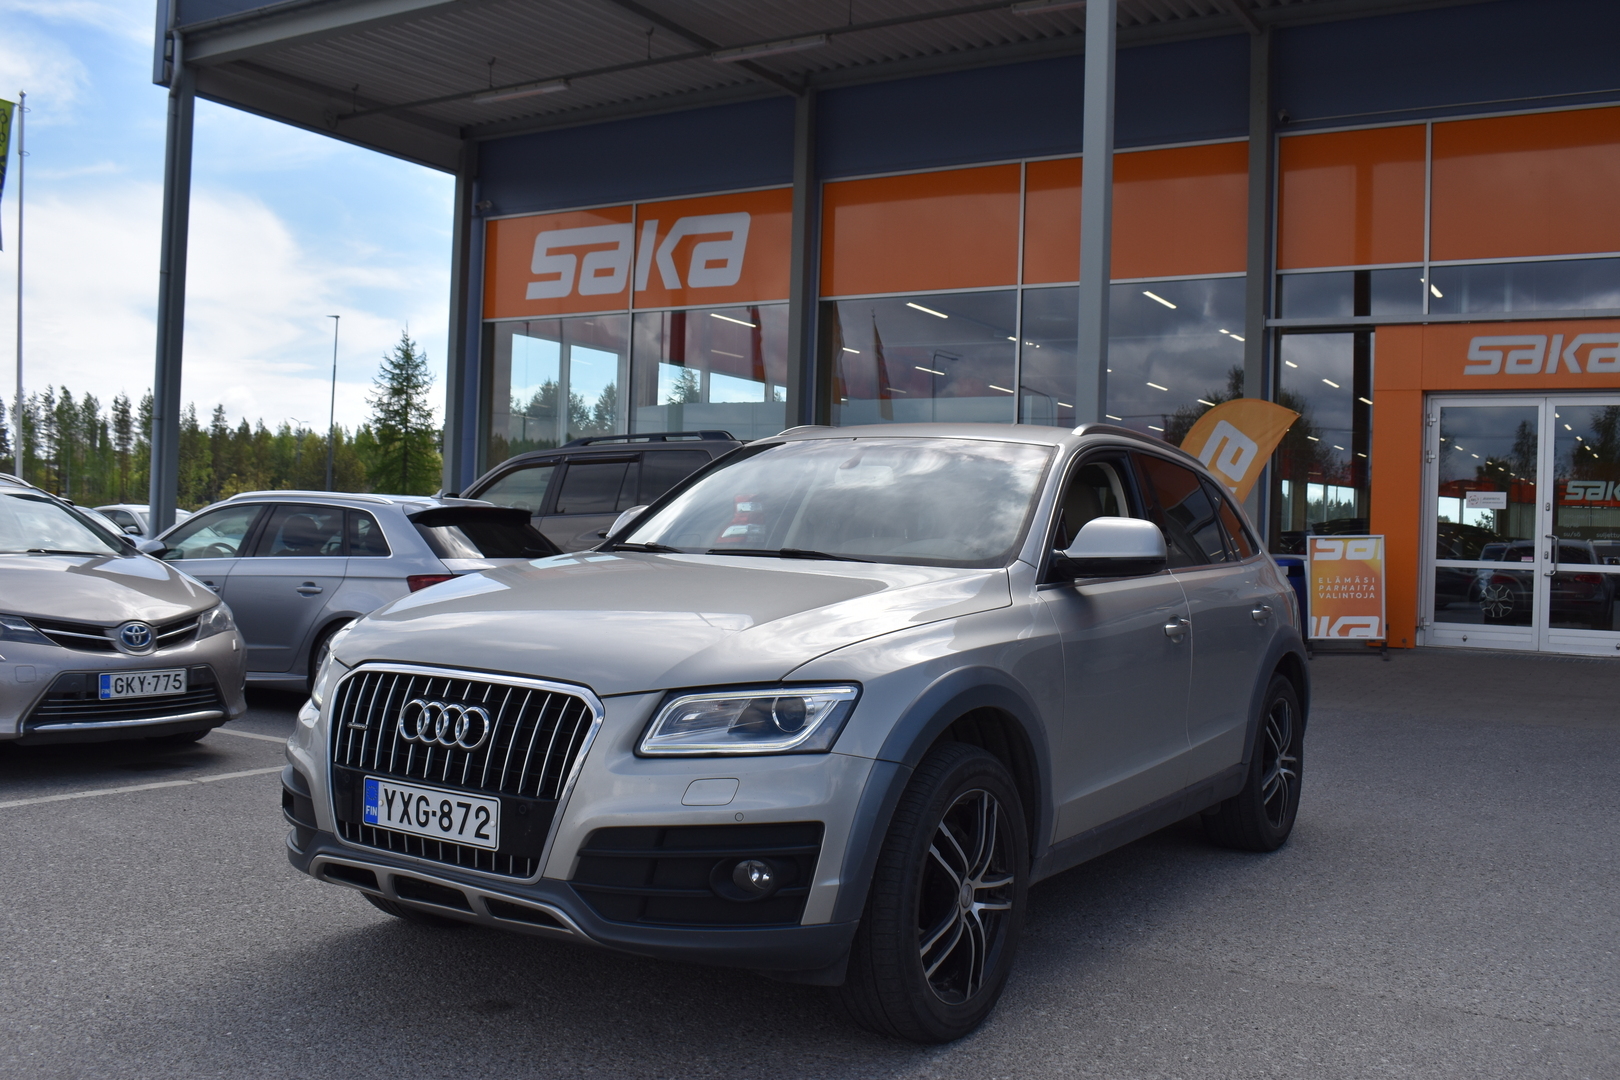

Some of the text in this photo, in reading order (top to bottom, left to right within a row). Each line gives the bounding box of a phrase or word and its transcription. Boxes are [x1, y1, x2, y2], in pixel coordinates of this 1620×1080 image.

[1318, 576, 1375, 584] ELÄMÄSI
[114, 674, 182, 694] GKY-775
[365, 788, 490, 840] FIN YXG-872
